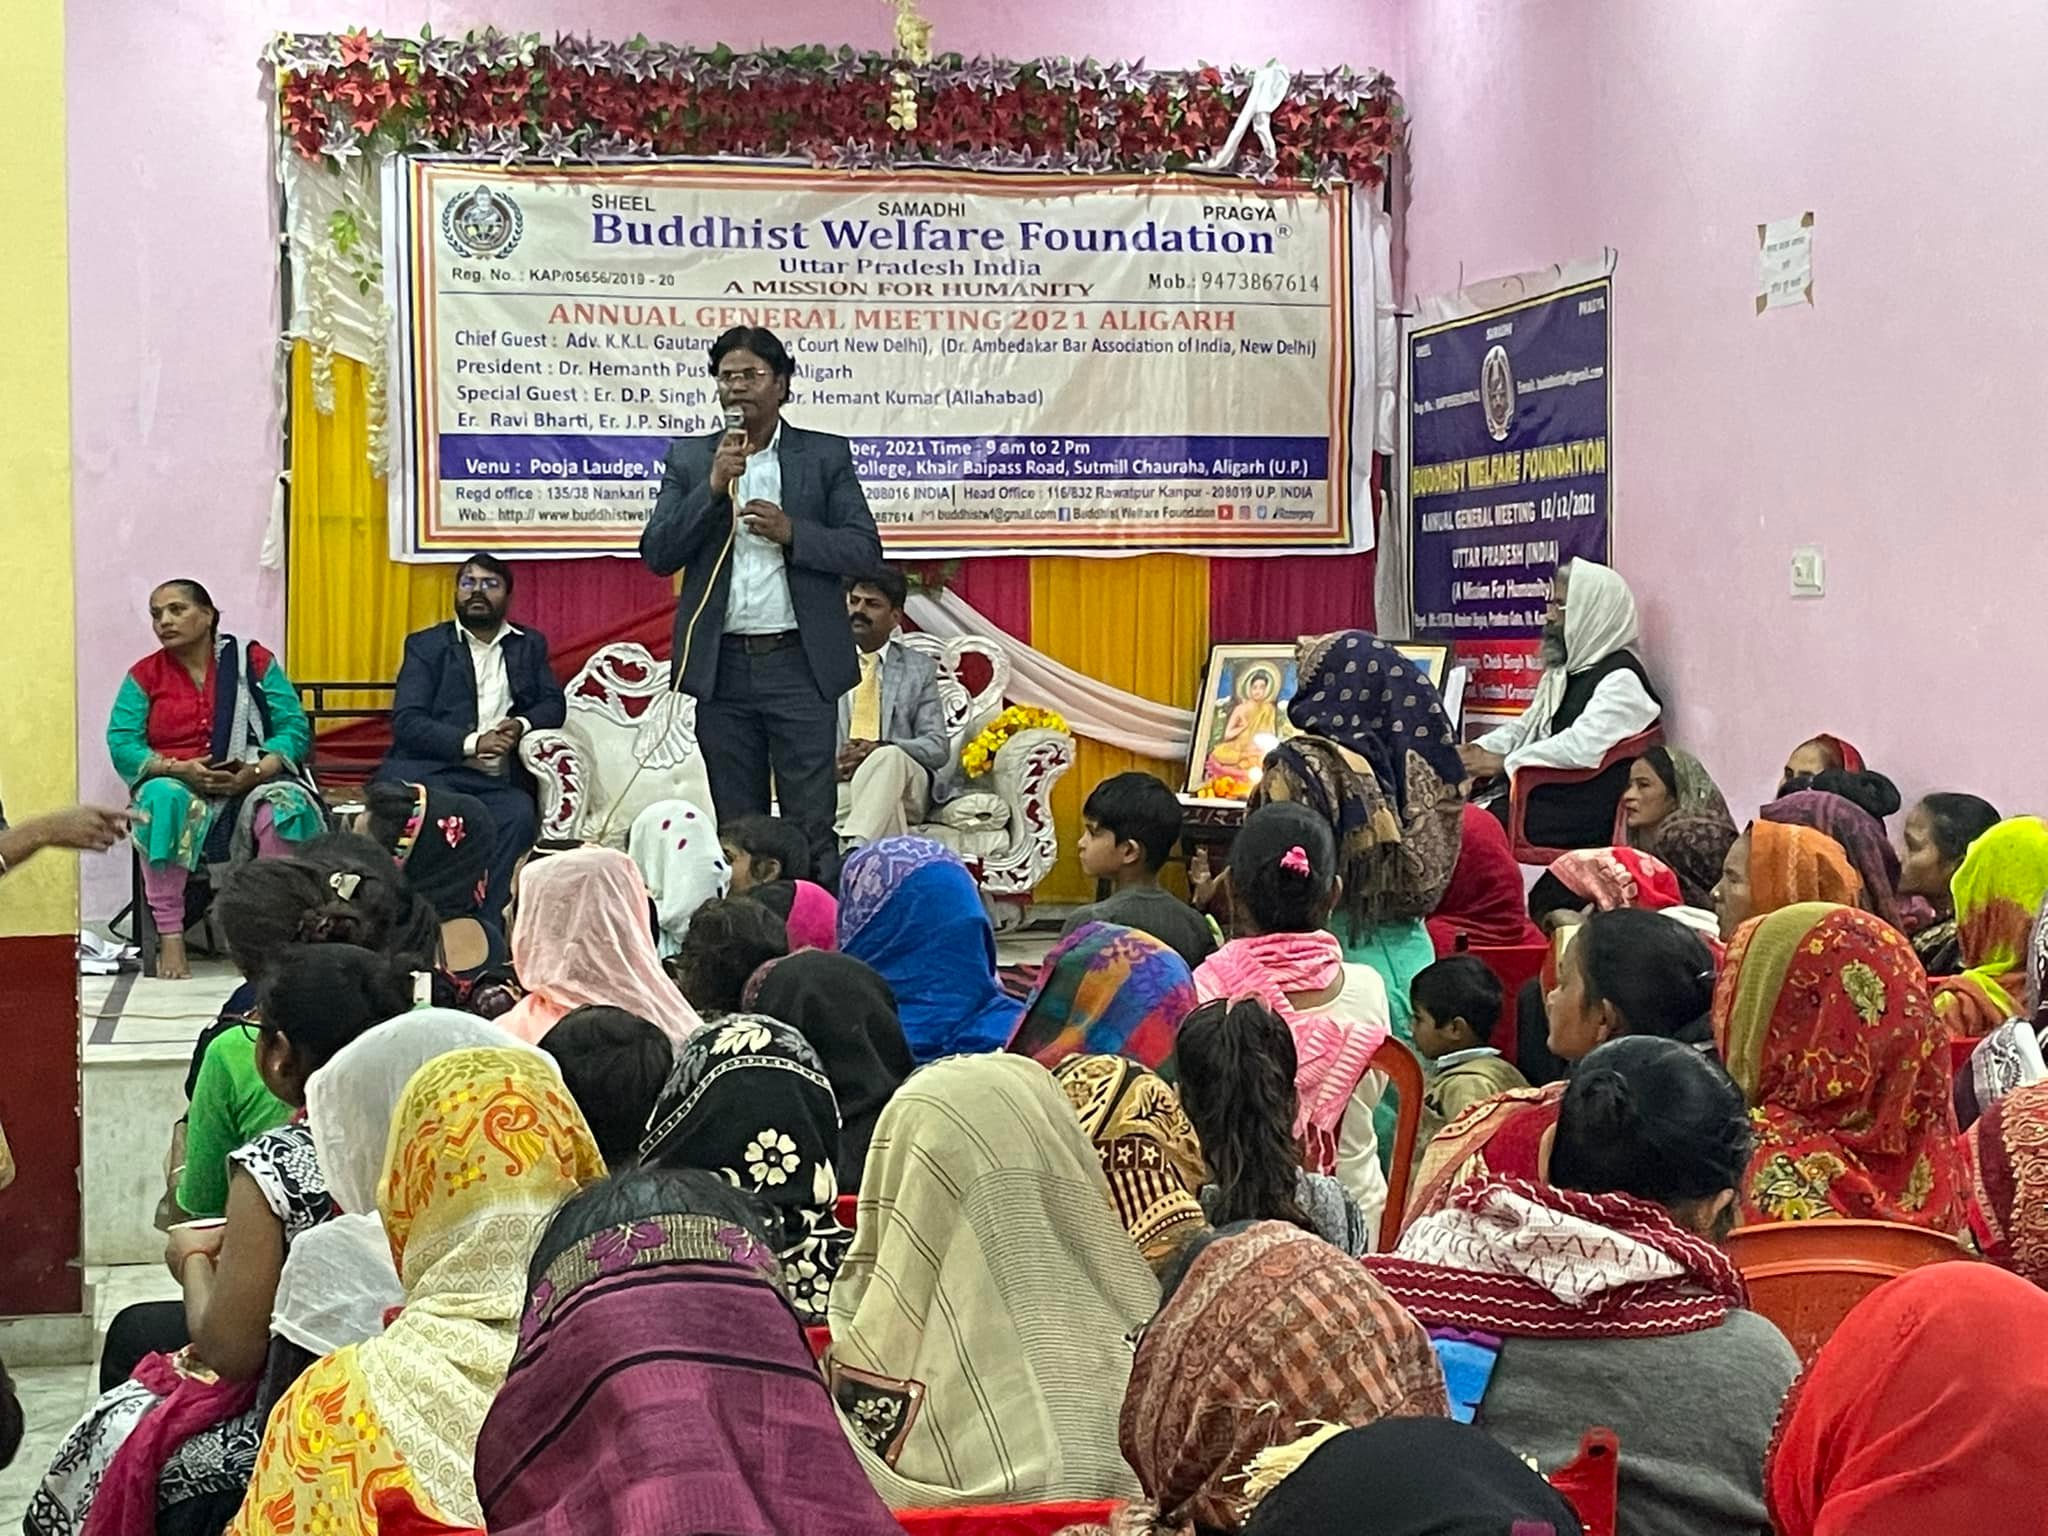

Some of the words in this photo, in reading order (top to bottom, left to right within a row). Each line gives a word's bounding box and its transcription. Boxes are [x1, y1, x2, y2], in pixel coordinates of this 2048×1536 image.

[592, 194, 656, 212] SHEEL
[878, 202, 966, 218] SAMADHI
[1203, 205, 1278, 222] PRAGYA
[592, 213, 809, 250] Buddhist
[821, 218, 1006, 252] Welfare
[452, 267, 485, 283] Reg.
[659, 274, 675, 286] 20
[780, 258, 849, 275] Uttar
[857, 258, 964, 277] Pradesh
[973, 258, 1042, 277] India
[723, 280, 744, 295] A
[752, 281, 868, 297] MISSION
[878, 282, 934, 297] FOR
[942, 282, 1096, 298] HUMANITY
[1201, 271, 1320, 293] 9473867614
[548, 303, 686, 327] ANNUAL
[696, 306, 846, 330] GENERAL
[854, 308, 1002, 332] MEETING
[1012, 309, 1088, 331] 2021
[1100, 310, 1236, 332] ALIGARH
[455, 329, 496, 347] Chief
[501, 331, 547, 348] Guest
[566, 333, 601, 349] Adv.
[606, 334, 648, 350] K.K.L.
[799, 337, 839, 353] Court
[844, 338, 879, 353] New
[941, 337, 966, 357] (Dr.
[972, 338, 1058, 354] Ambedakar
[1063, 338, 1086, 353] Bar
[1091, 338, 1174, 353] Association
[1178, 337, 1193, 352] of
[1196, 338, 1236, 357] India,
[1240, 338, 1273, 355] New
[1277, 339, 1316, 359] Delhi)
[457, 358, 543, 375] President
[559, 361, 583, 375] Dr.
[589, 360, 670, 377] Hemanth
[457, 385, 521, 404] Special
[526, 386, 578, 402] Guest
[594, 387, 615, 402] Er.
[621, 388, 653, 403] D.P.
[659, 388, 706, 406] Singh
[812, 390, 881, 405] Hemant
[886, 390, 941, 405] Kumar
[945, 388, 1044, 408] (Allahabad)
[458, 412, 479, 427] Er.
[491, 412, 528, 427] Ravi
[534, 412, 593, 431] Bharti,
[599, 415, 619, 429] Er.
[625, 415, 655, 430] J.P.
[658, 414, 706, 434] Singh
[885, 440, 926, 456] 2021
[929, 440, 972, 456] Time
[986, 440, 996, 456] 9
[1001, 442, 1025, 456] am
[1030, 441, 1047, 456] to
[1051, 441, 1061, 456] 2
[1064, 441, 1091, 456] Pm
[466, 458, 510, 474] Venu
[530, 458, 578, 478] Pooja
[583, 458, 649, 479] Laudge,
[916, 460, 959, 476] Khair
[963, 460, 1022, 478] Baipass
[1025, 460, 1070, 477] Road,
[1074, 459, 1129, 475] Sutmill
[1132, 459, 1209, 477] Chauraha,
[1212, 459, 1265, 479] Aligarh
[1268, 459, 1308, 478] (U.P.)
[1412, 461, 1466, 496] BUDDHIST
[1467, 452, 1522, 491] WELFARE
[1522, 438, 1606, 484] FOUNDATION
[456, 486, 490, 503] Regd
[495, 486, 533, 500] office
[593, 486, 645, 501] Nankari
[914, 486, 950, 500] INDIA
[964, 486, 996, 500] Head
[999, 486, 1035, 500] Office
[1158, 485, 1203, 503] Kanpur
[1280, 486, 1313, 500] INDIA
[1494, 501, 1537, 526] MEETING
[1540, 489, 1597, 523] 12/12/2021
[1452, 547, 1481, 569] UTTAR
[1481, 543, 1525, 567] PRADESH
